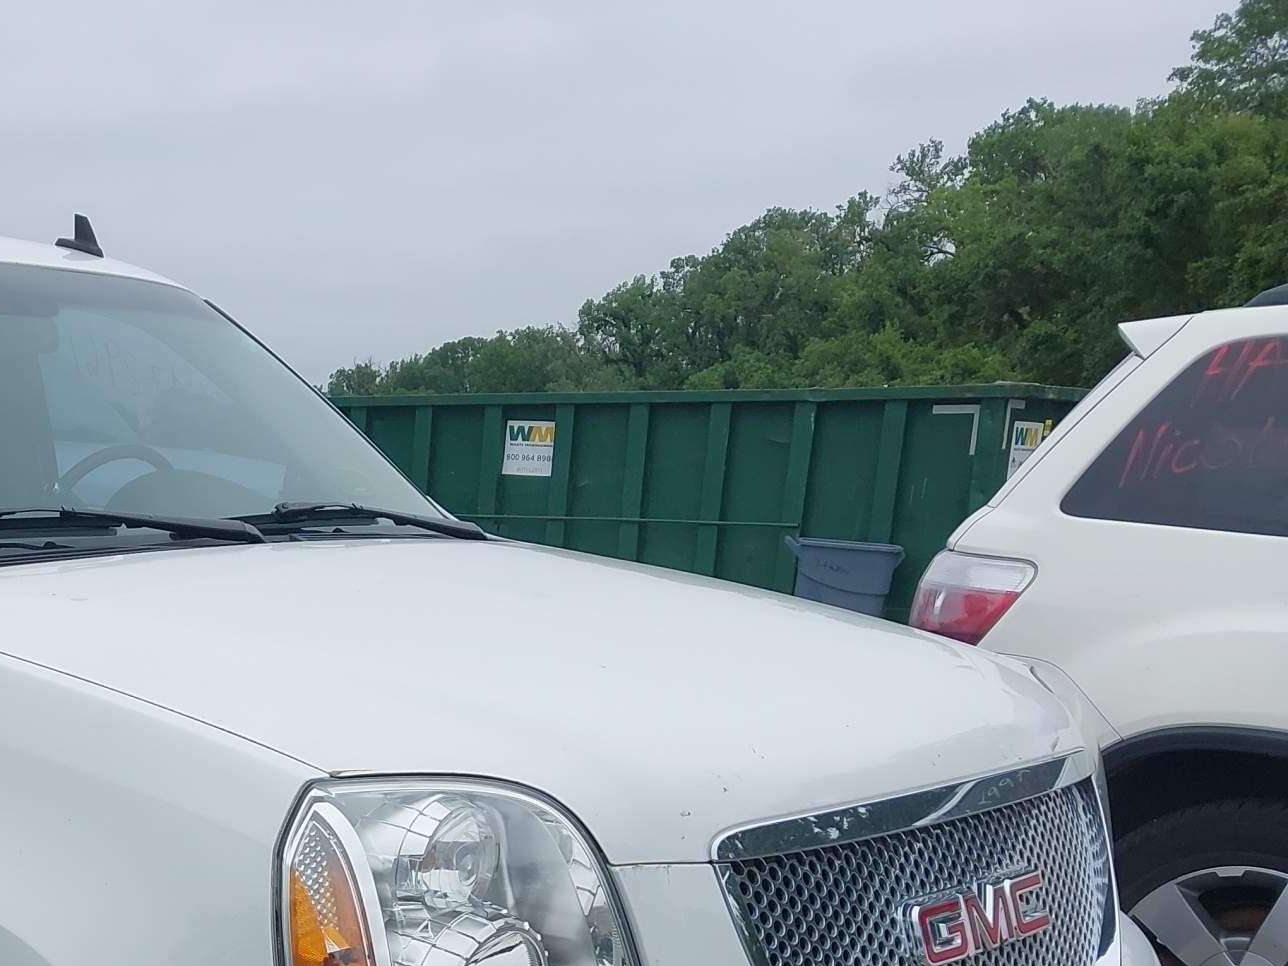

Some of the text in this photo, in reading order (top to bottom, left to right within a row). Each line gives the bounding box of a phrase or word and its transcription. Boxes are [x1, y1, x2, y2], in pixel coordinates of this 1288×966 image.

[509, 426, 554, 442] WM
[1014, 426, 1039, 447] WM
[506, 453, 520, 461] 800
[521, 454, 535, 462] 964
[910, 870, 1050, 966] GMC
